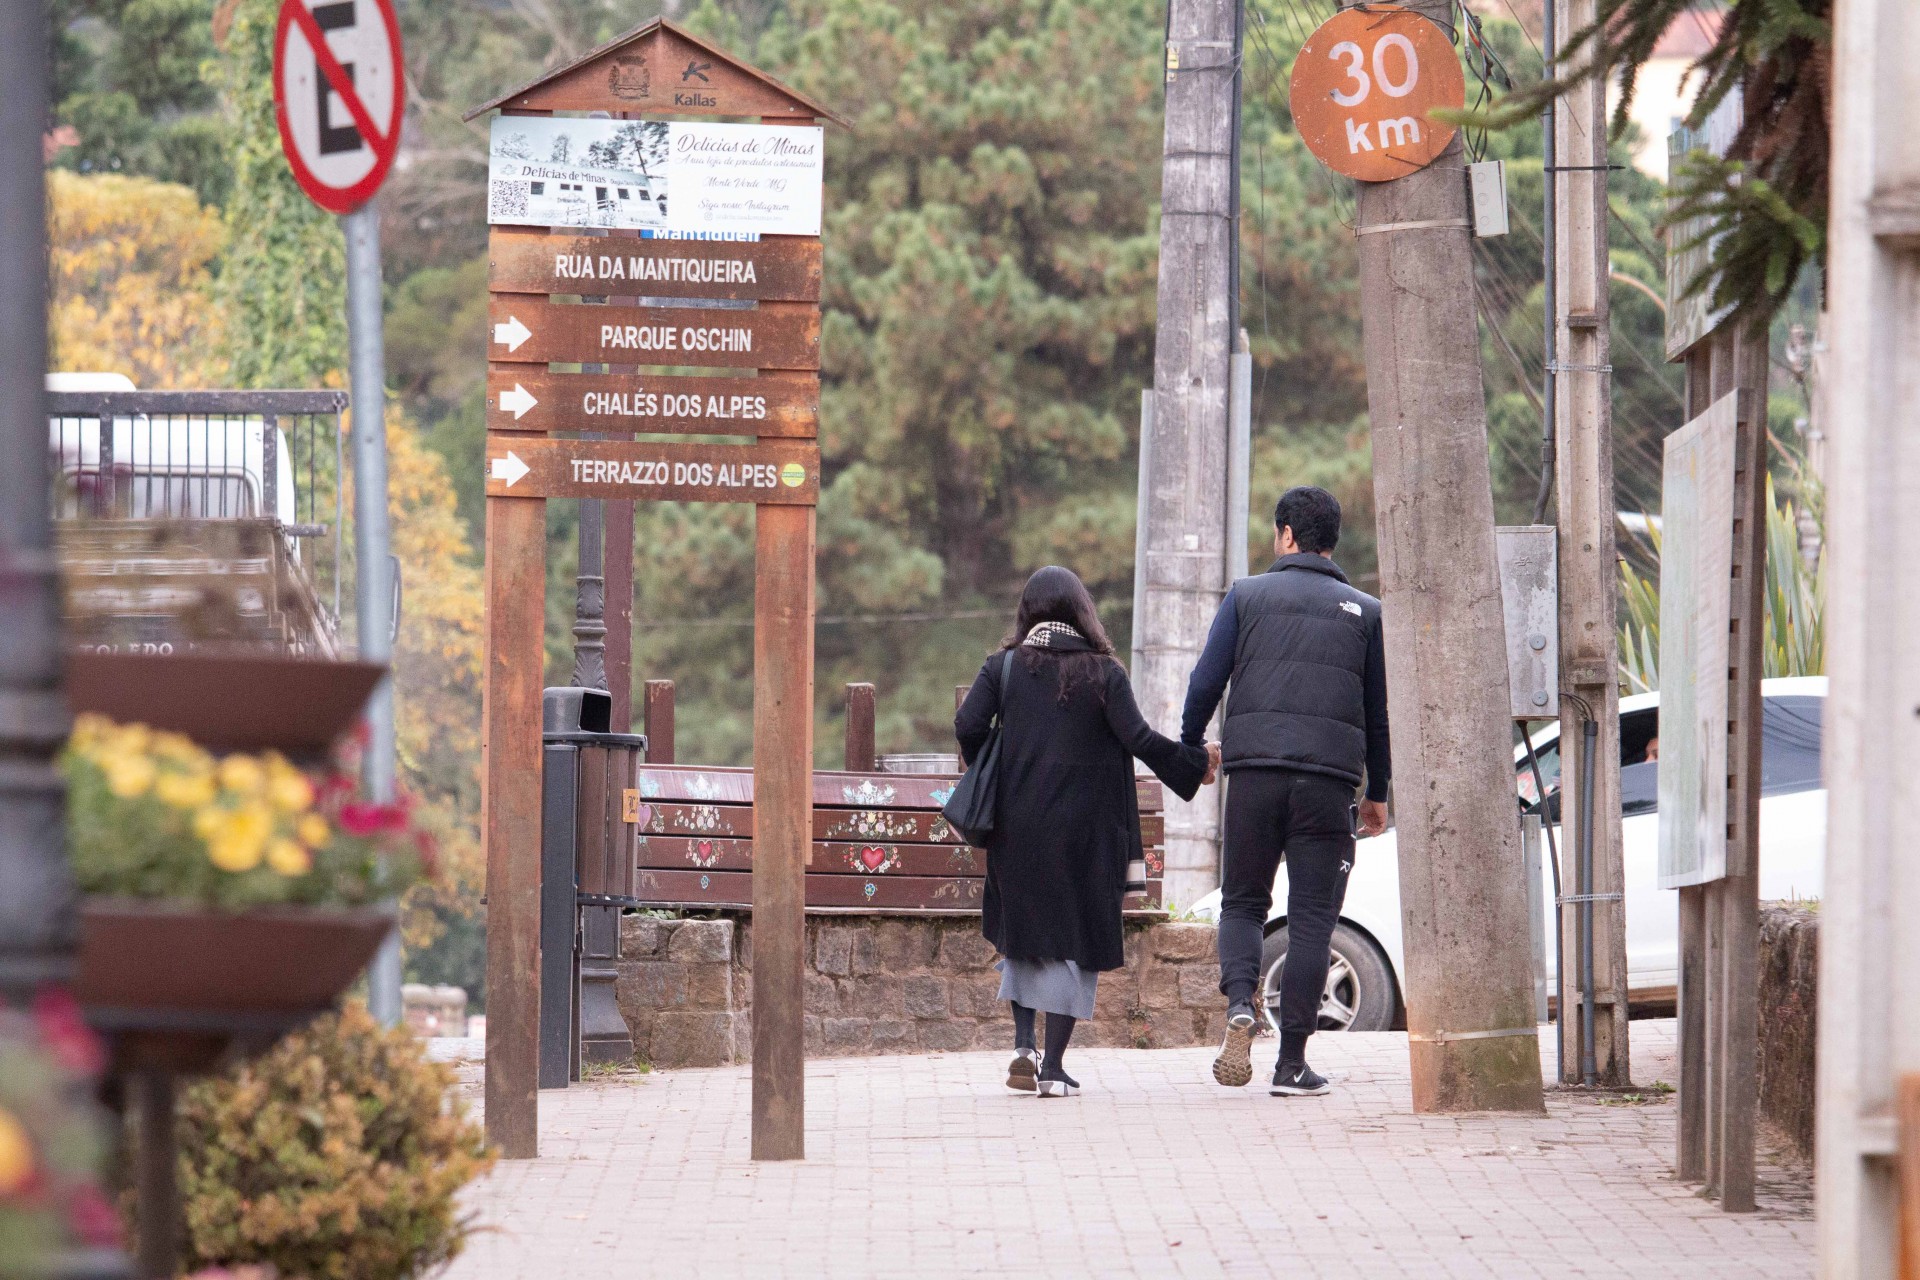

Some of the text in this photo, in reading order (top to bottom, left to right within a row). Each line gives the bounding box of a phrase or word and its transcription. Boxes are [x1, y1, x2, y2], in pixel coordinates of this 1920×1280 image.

[1328, 33, 1419, 107] 30
[674, 93, 717, 107] Kallas
[678, 134, 815, 156] Delícias de Minas
[1345, 116, 1420, 155] km
[521, 165, 567, 180] Delícias
[568, 170, 580, 181] de
[581, 173, 606, 183] Minas
[735, 157, 772, 167] produtos
[703, 176, 731, 188] Monte
[733, 178, 760, 189] Verde
[698, 198, 719, 211] Siga
[744, 200, 790, 213] Instagram
[556, 255, 757, 284] RUA DA MANTIQUEIRA
[601, 325, 752, 352] PARQUE OSCHIN
[583, 388, 766, 419] CHALÉS DOS ALPES
[571, 459, 777, 488] TERRAZZO DOS ALPES
